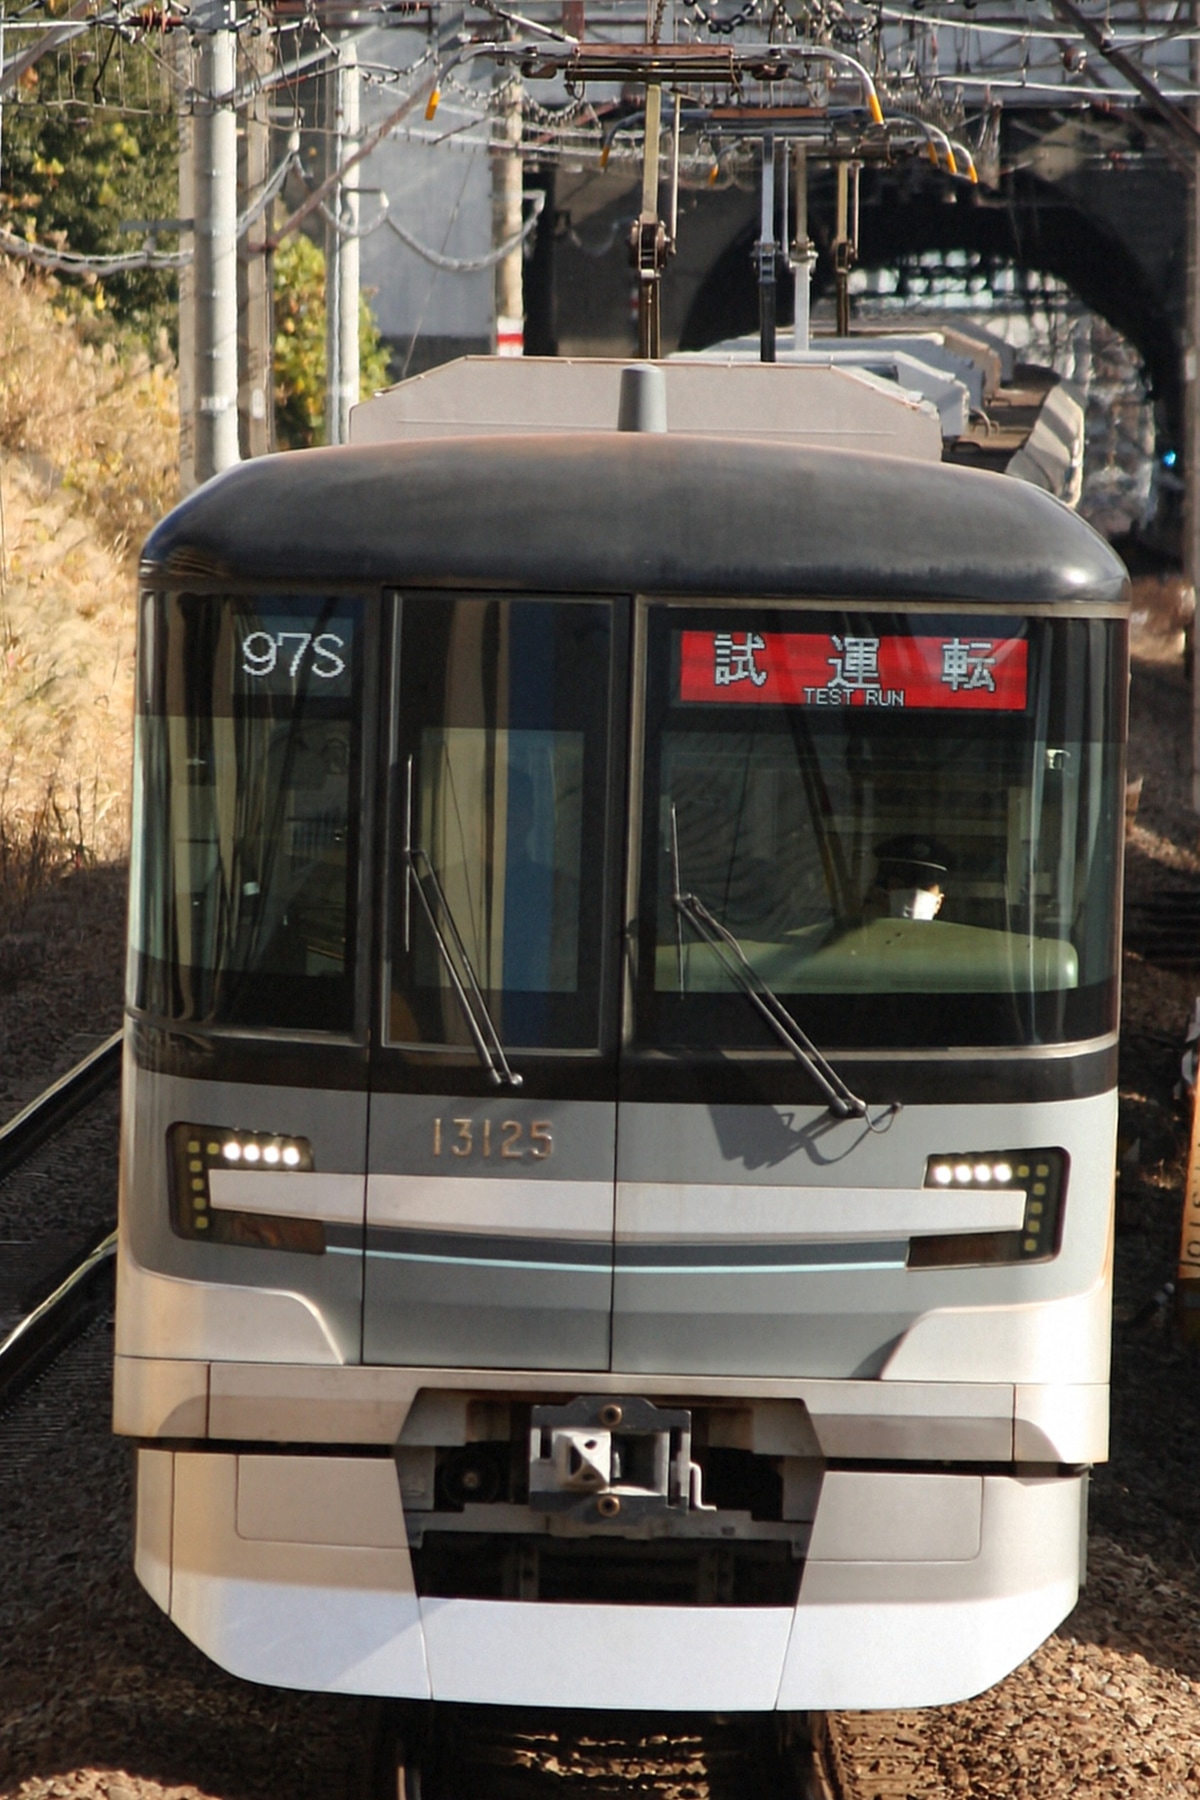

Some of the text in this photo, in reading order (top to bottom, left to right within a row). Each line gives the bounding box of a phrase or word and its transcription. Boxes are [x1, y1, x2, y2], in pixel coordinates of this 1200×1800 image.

[242, 631, 346, 678] 97S
[714, 632, 996, 691] 試運転
[803, 687, 905, 707] TEST RUN
[433, 1117, 555, 1160] 13125
